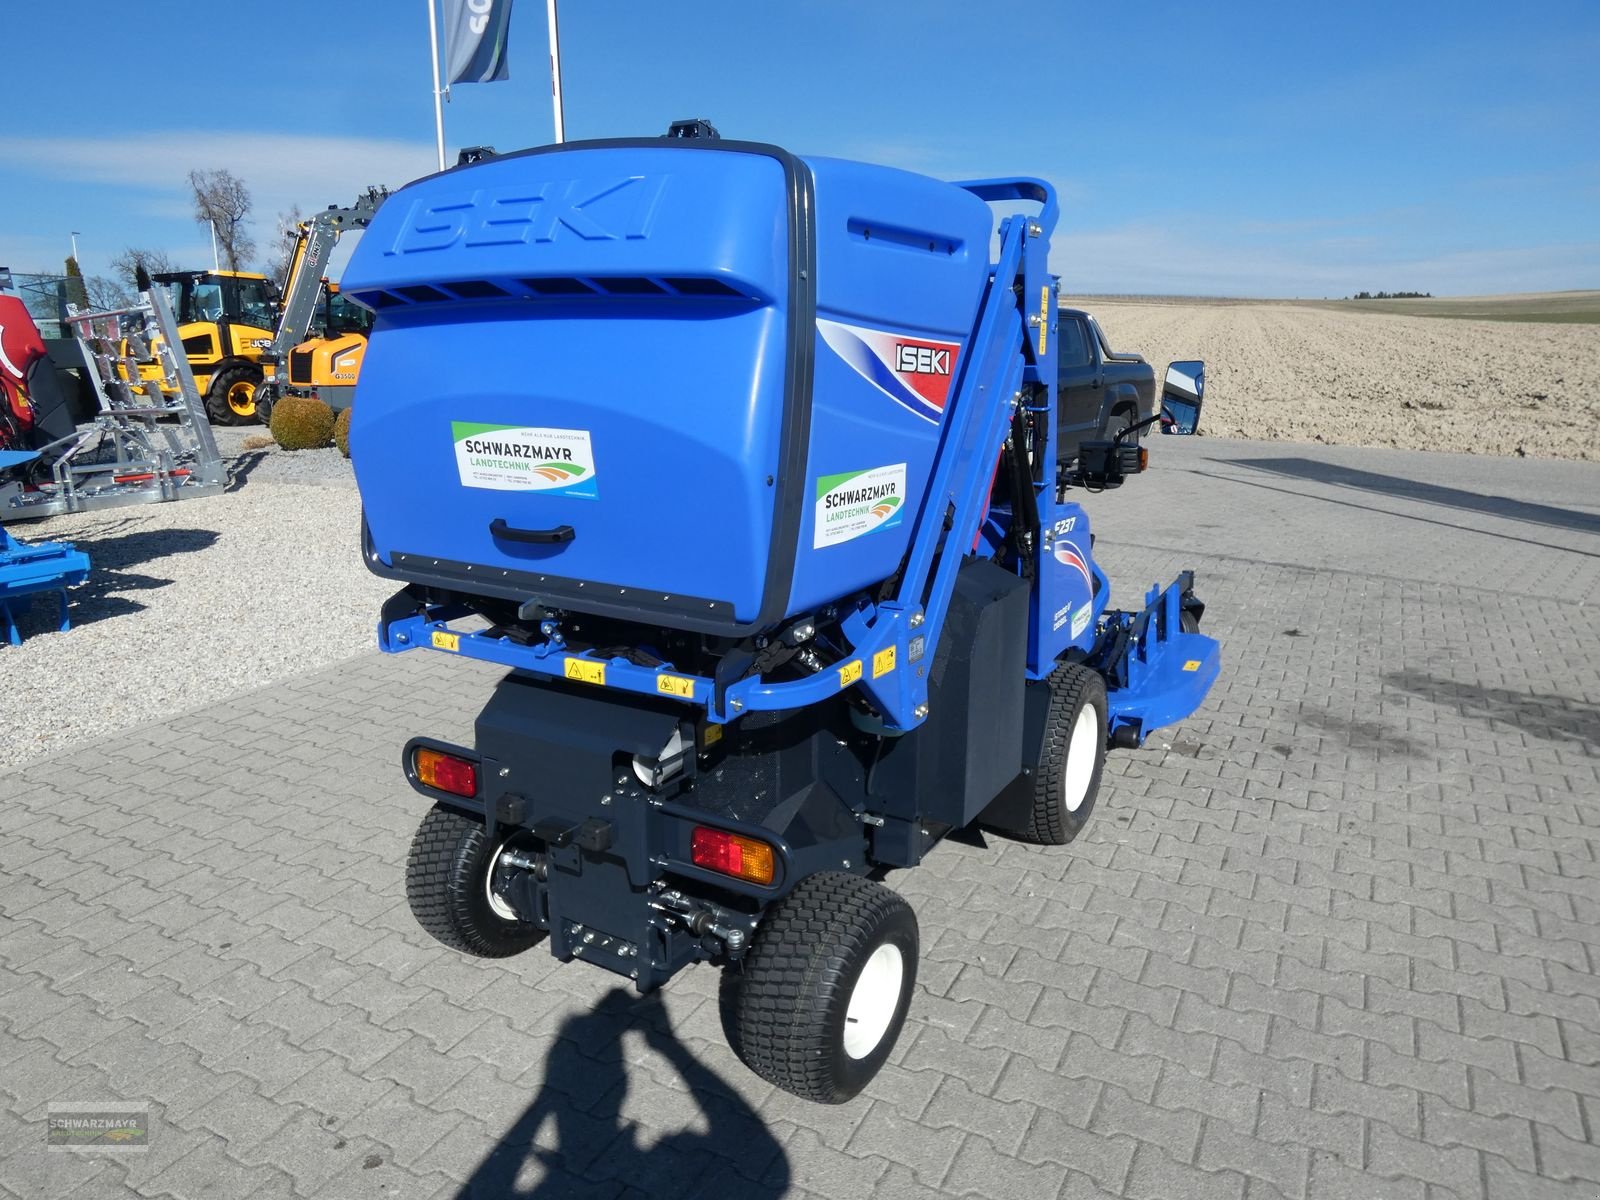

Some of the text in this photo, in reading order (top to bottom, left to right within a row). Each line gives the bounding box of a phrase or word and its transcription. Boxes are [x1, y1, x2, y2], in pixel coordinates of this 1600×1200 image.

[383, 174, 671, 256] ISEKI
[308, 240, 322, 267] GIANT
[251, 339, 271, 348] JCB
[896, 343, 950, 376] ISEKI
[465, 439, 573, 461] SCHWARZMAYR
[470, 457, 531, 472] LANDTECHNIK
[825, 482, 896, 509] SCHWARZMAYR
[826, 505, 870, 523] LANDTECHNIK
